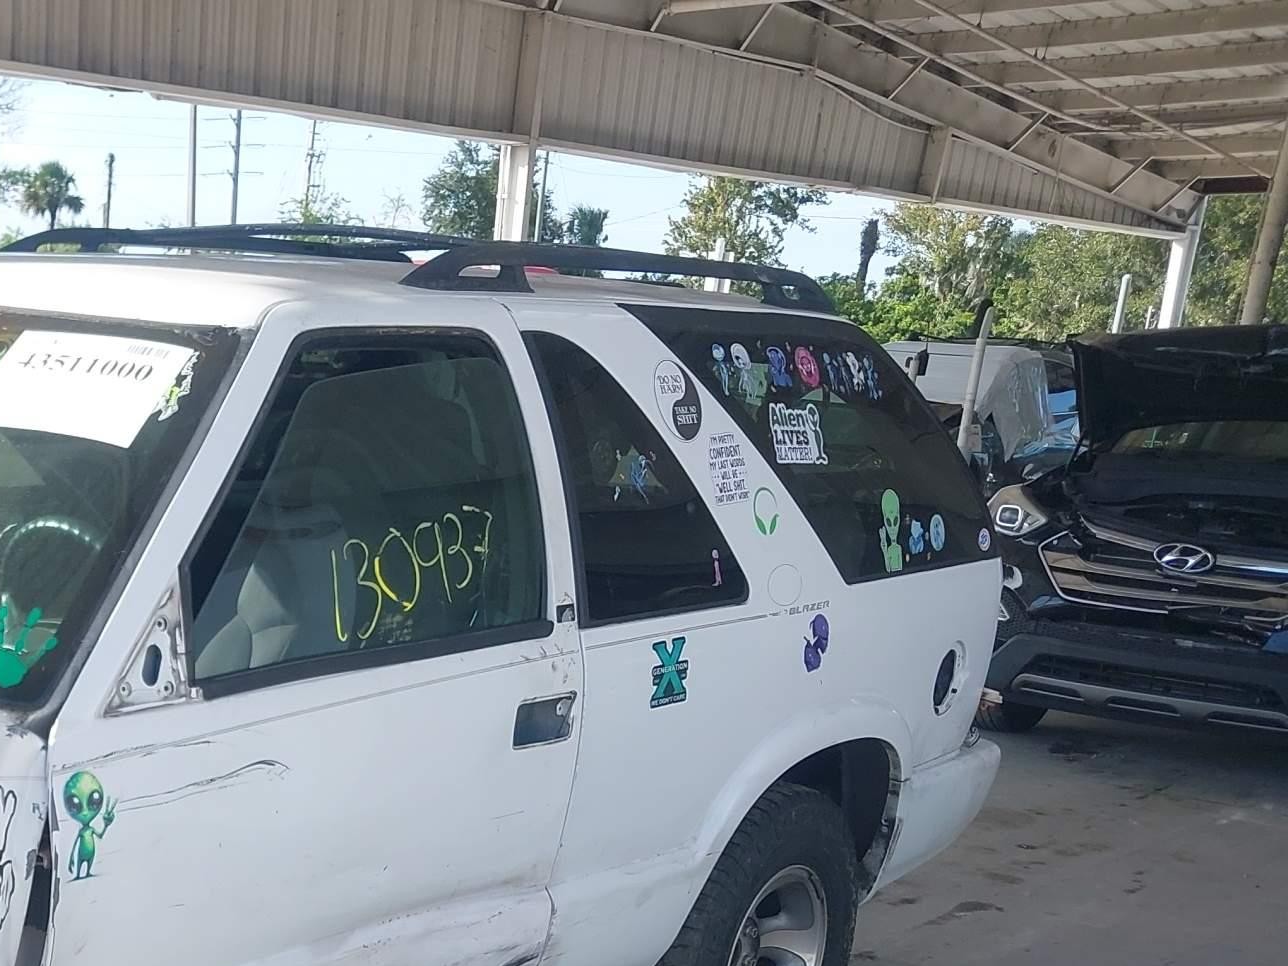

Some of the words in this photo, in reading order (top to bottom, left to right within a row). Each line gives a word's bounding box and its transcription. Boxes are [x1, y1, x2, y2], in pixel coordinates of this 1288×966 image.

[17, 351, 154, 381] 43511000
[657, 375, 670, 385] DO
[670, 374, 682, 384] NO
[660, 384, 684, 395] HARM
[674, 405, 688, 415] TAKE
[688, 405, 697, 413] NO
[771, 405, 807, 428] Alien
[676, 414, 698, 426] SHIT
[717, 434, 735, 444] PRETTY
[773, 429, 809, 446] LIVES
[709, 445, 741, 460] CONFIDENT
[776, 446, 813, 461] MATTER!
[709, 462, 717, 472] MY
[717, 459, 730, 470] LAST
[330, 504, 494, 643] 130937
[789, 600, 830, 616] BLAZER
[653, 661, 688, 676] GENERATION
